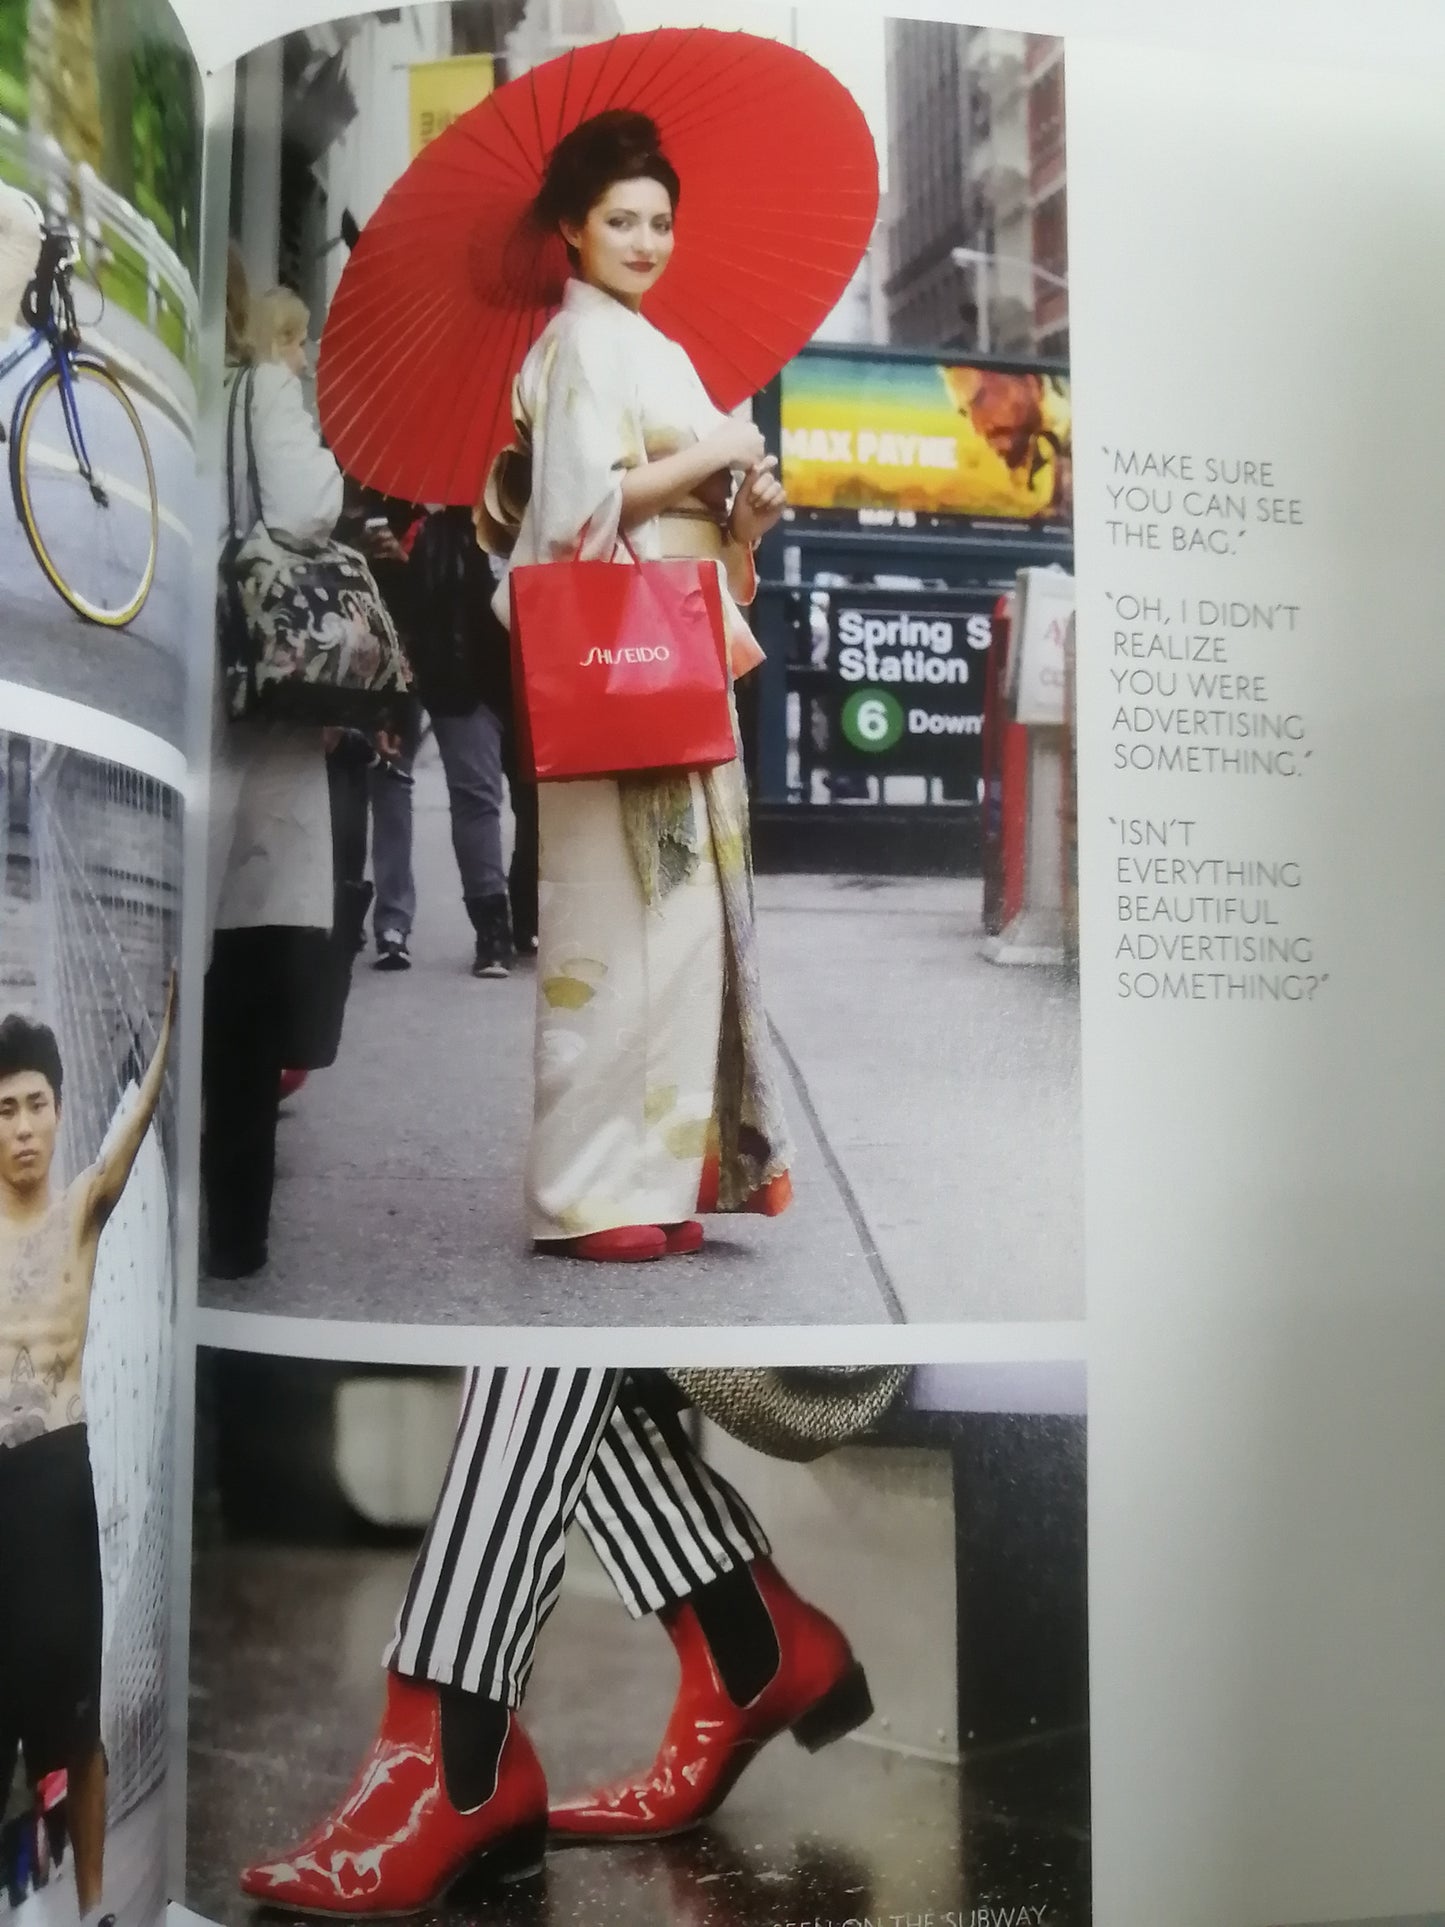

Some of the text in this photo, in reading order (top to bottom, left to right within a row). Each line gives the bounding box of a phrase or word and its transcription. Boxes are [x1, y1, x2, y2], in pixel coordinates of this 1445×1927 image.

[1205, 457, 1275, 488] SURE
[1106, 484, 1304, 526] YOU CAN SEE
[1106, 520, 1162, 550] THE
[1181, 598, 1188, 625] I
[1198, 599, 1301, 631] DIDN’T
[838, 610, 953, 654] Spring
[1113, 631, 1229, 664] REALIZE
[579, 646, 670, 667] SHISEIDO
[838, 647, 969, 684] Station
[1110, 668, 1269, 702] YOU WERE
[857, 699, 889, 741] 6
[1112, 706, 1306, 740] ADVERTISING
[1117, 856, 1301, 888] EVERYTHING
[1118, 895, 1279, 925] BEAUTIFUL
[1115, 933, 1313, 963] ADVERTISING
[946, 1904, 1047, 1927] SUBWAY
